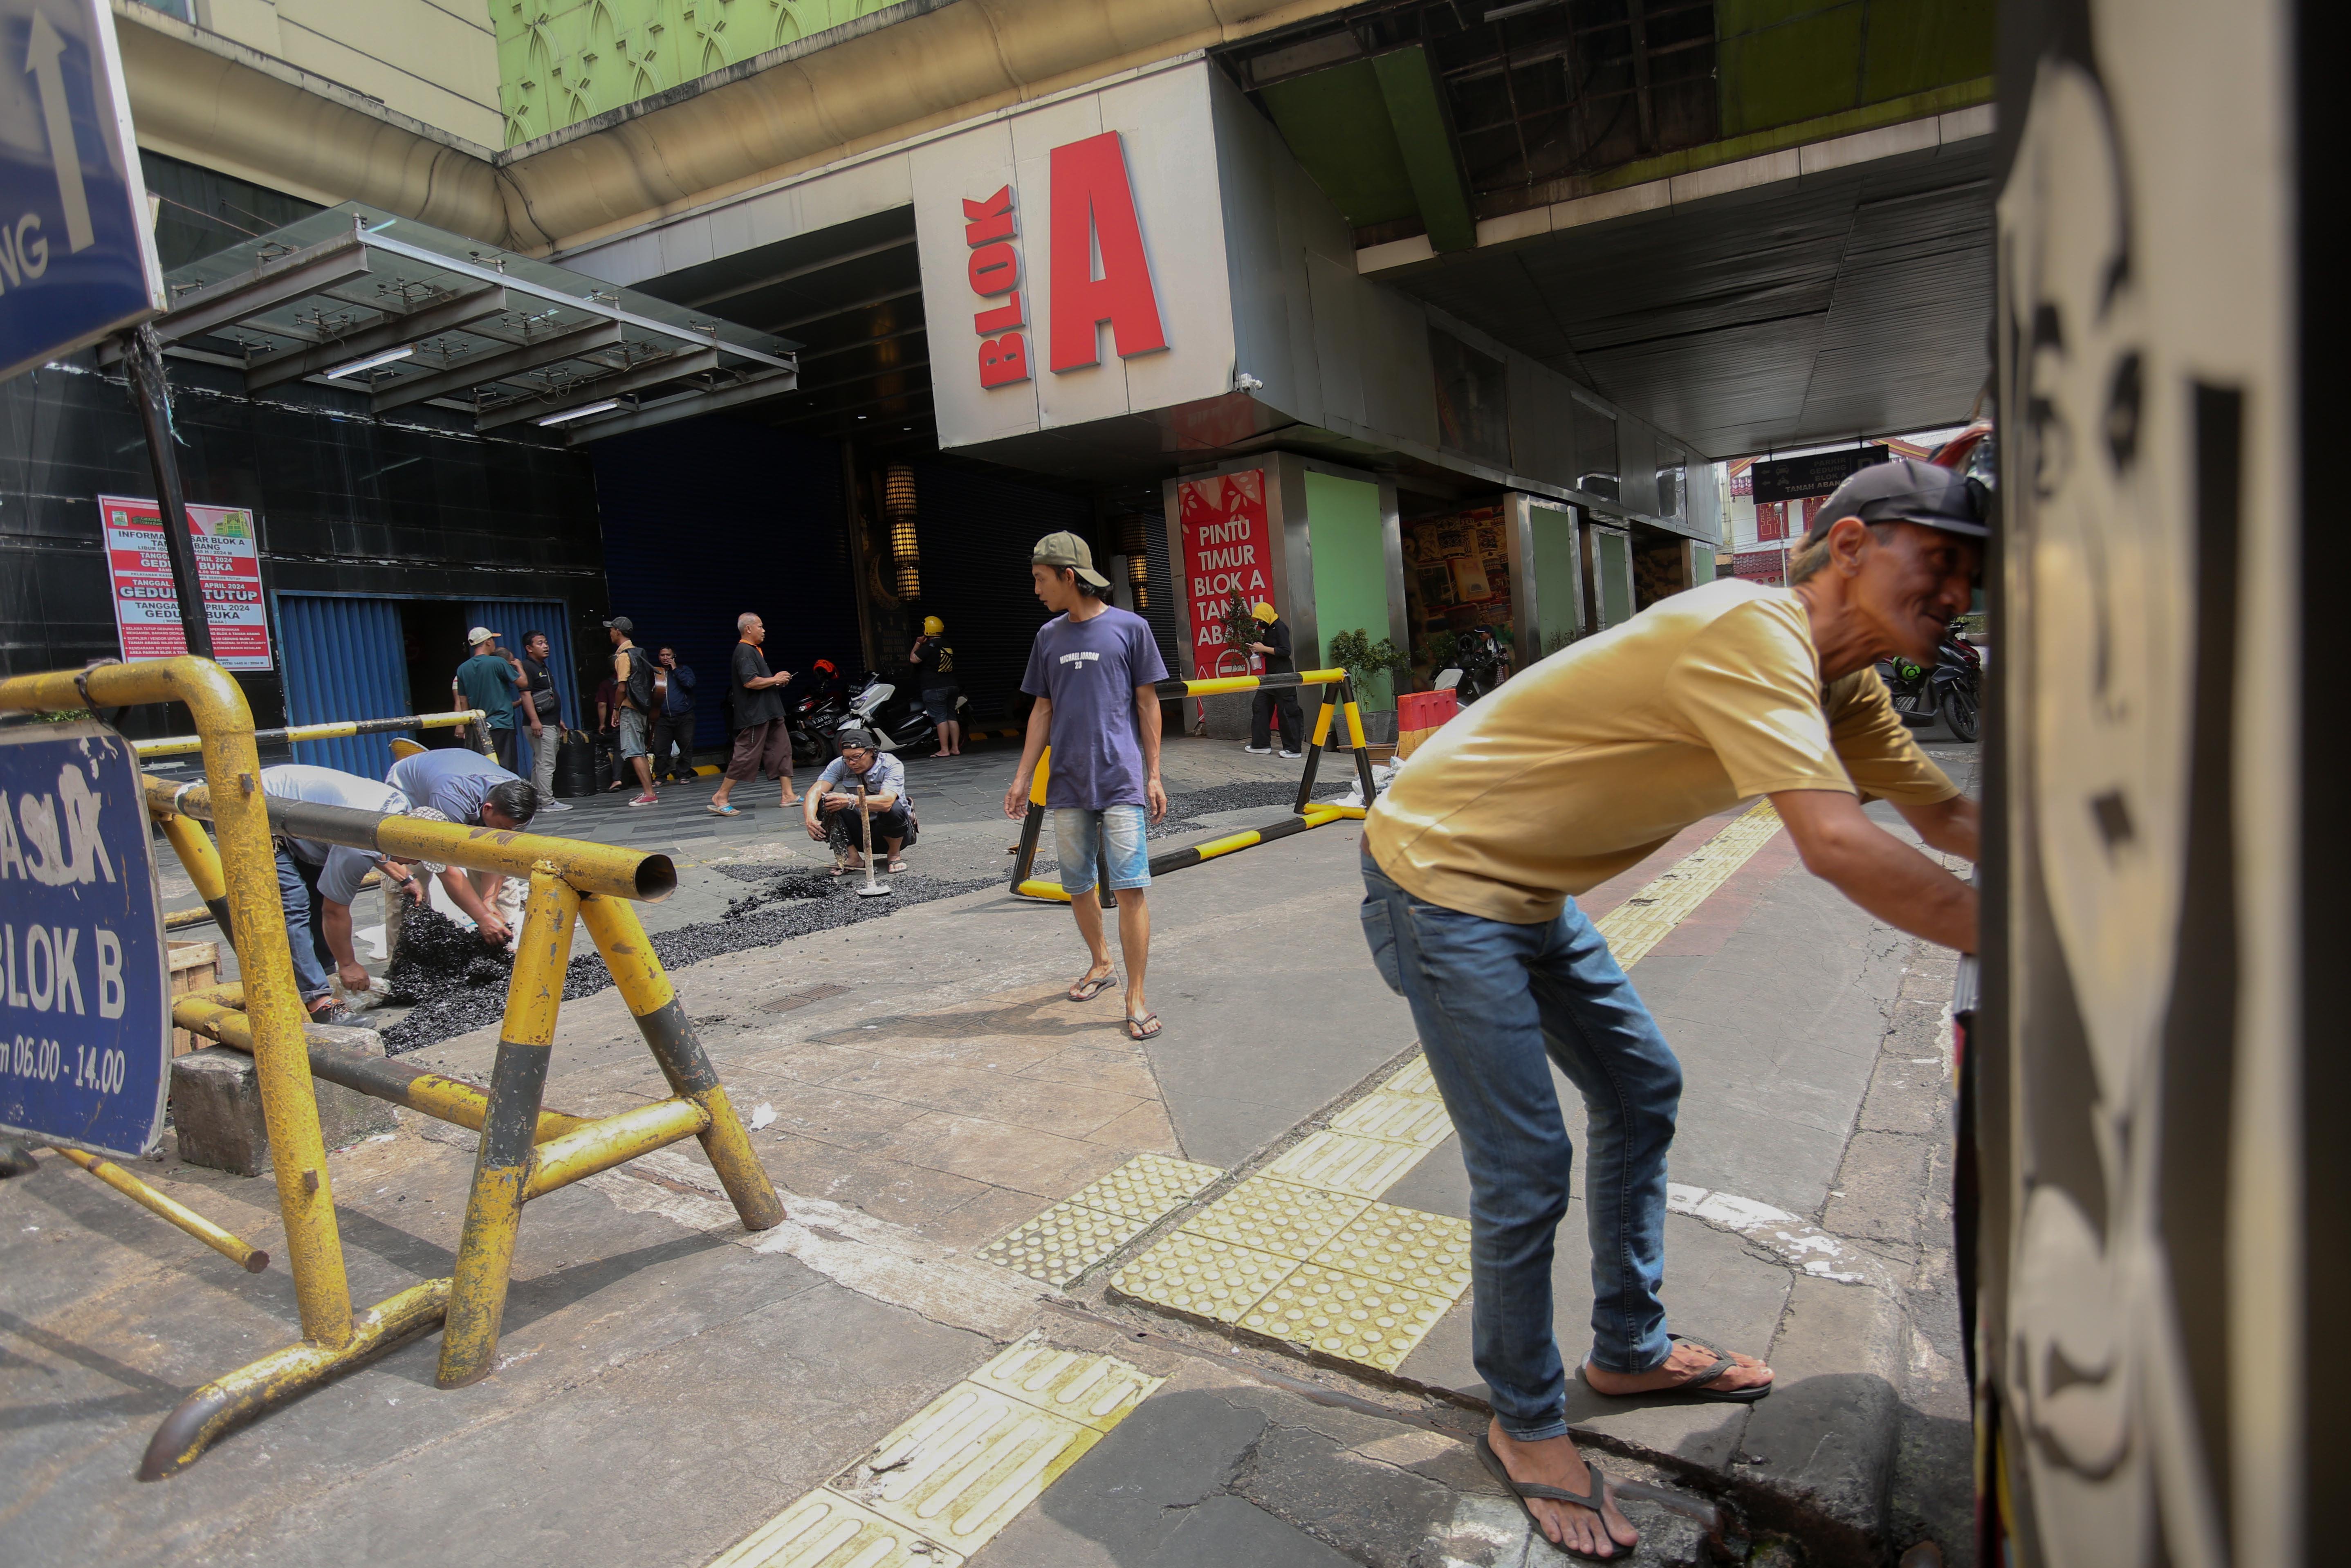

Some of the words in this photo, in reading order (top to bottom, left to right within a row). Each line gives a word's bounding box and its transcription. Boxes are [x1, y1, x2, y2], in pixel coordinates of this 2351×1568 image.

[0, 213, 49, 296] NG
[962, 184, 1031, 389] BLOK
[1050, 130, 1170, 375] A
[1814, 457, 1846, 467] PARKIR
[1810, 464, 1846, 475] GEDUNG
[1815, 473, 1838, 482] BLOK
[1785, 483, 1815, 493] TANAH
[1817, 480, 1841, 489] ABAN
[119, 531, 166, 540] INFORMA
[1199, 519, 1250, 546] PINTU
[1198, 545, 1255, 571] TIMUR
[199, 562, 234, 571] BUKA
[1194, 572, 1244, 597] BLOK
[1249, 569, 1265, 590] A
[120, 586, 177, 599] GEDU
[202, 589, 258, 601] TUTUP
[145, 610, 181, 618] GEDU
[1059, 652, 1080, 664] MICHAEL
[1080, 651, 1099, 661] JORDAN
[1075, 661, 1082, 669] 23
[0, 764, 117, 886] ASUK
[0, 924, 85, 1015] LOK
[95, 924, 125, 1019] B
[14, 1034, 60, 1082] 06.00
[76, 1044, 125, 1094] 14.00
